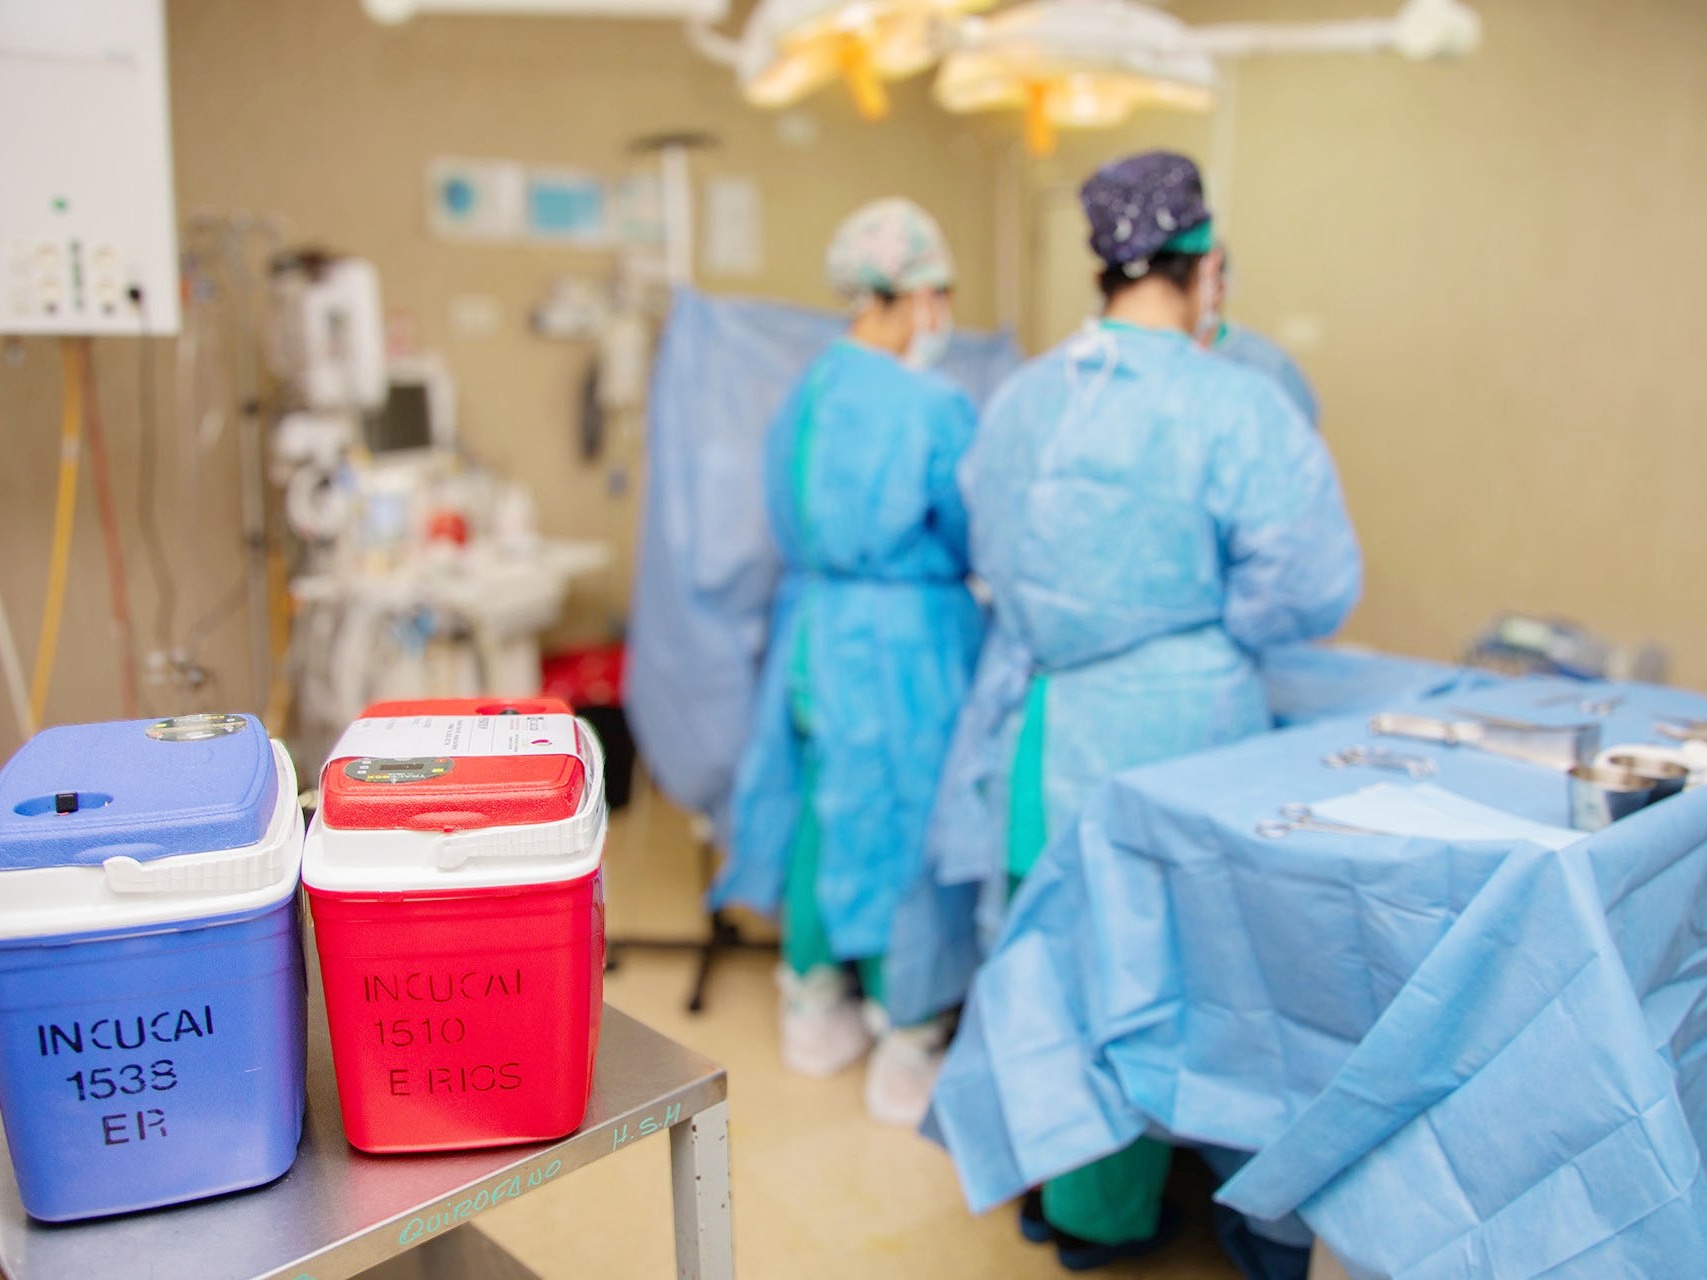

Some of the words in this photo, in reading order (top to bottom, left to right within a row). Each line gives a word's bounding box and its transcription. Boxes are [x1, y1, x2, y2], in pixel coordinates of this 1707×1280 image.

[363, 969, 522, 1003] INCUCAI
[37, 1005, 214, 1057] INCUCAI
[375, 1017, 466, 1047] 1510
[65, 1058, 178, 1102] 1538
[428, 1062, 523, 1095] RIOS
